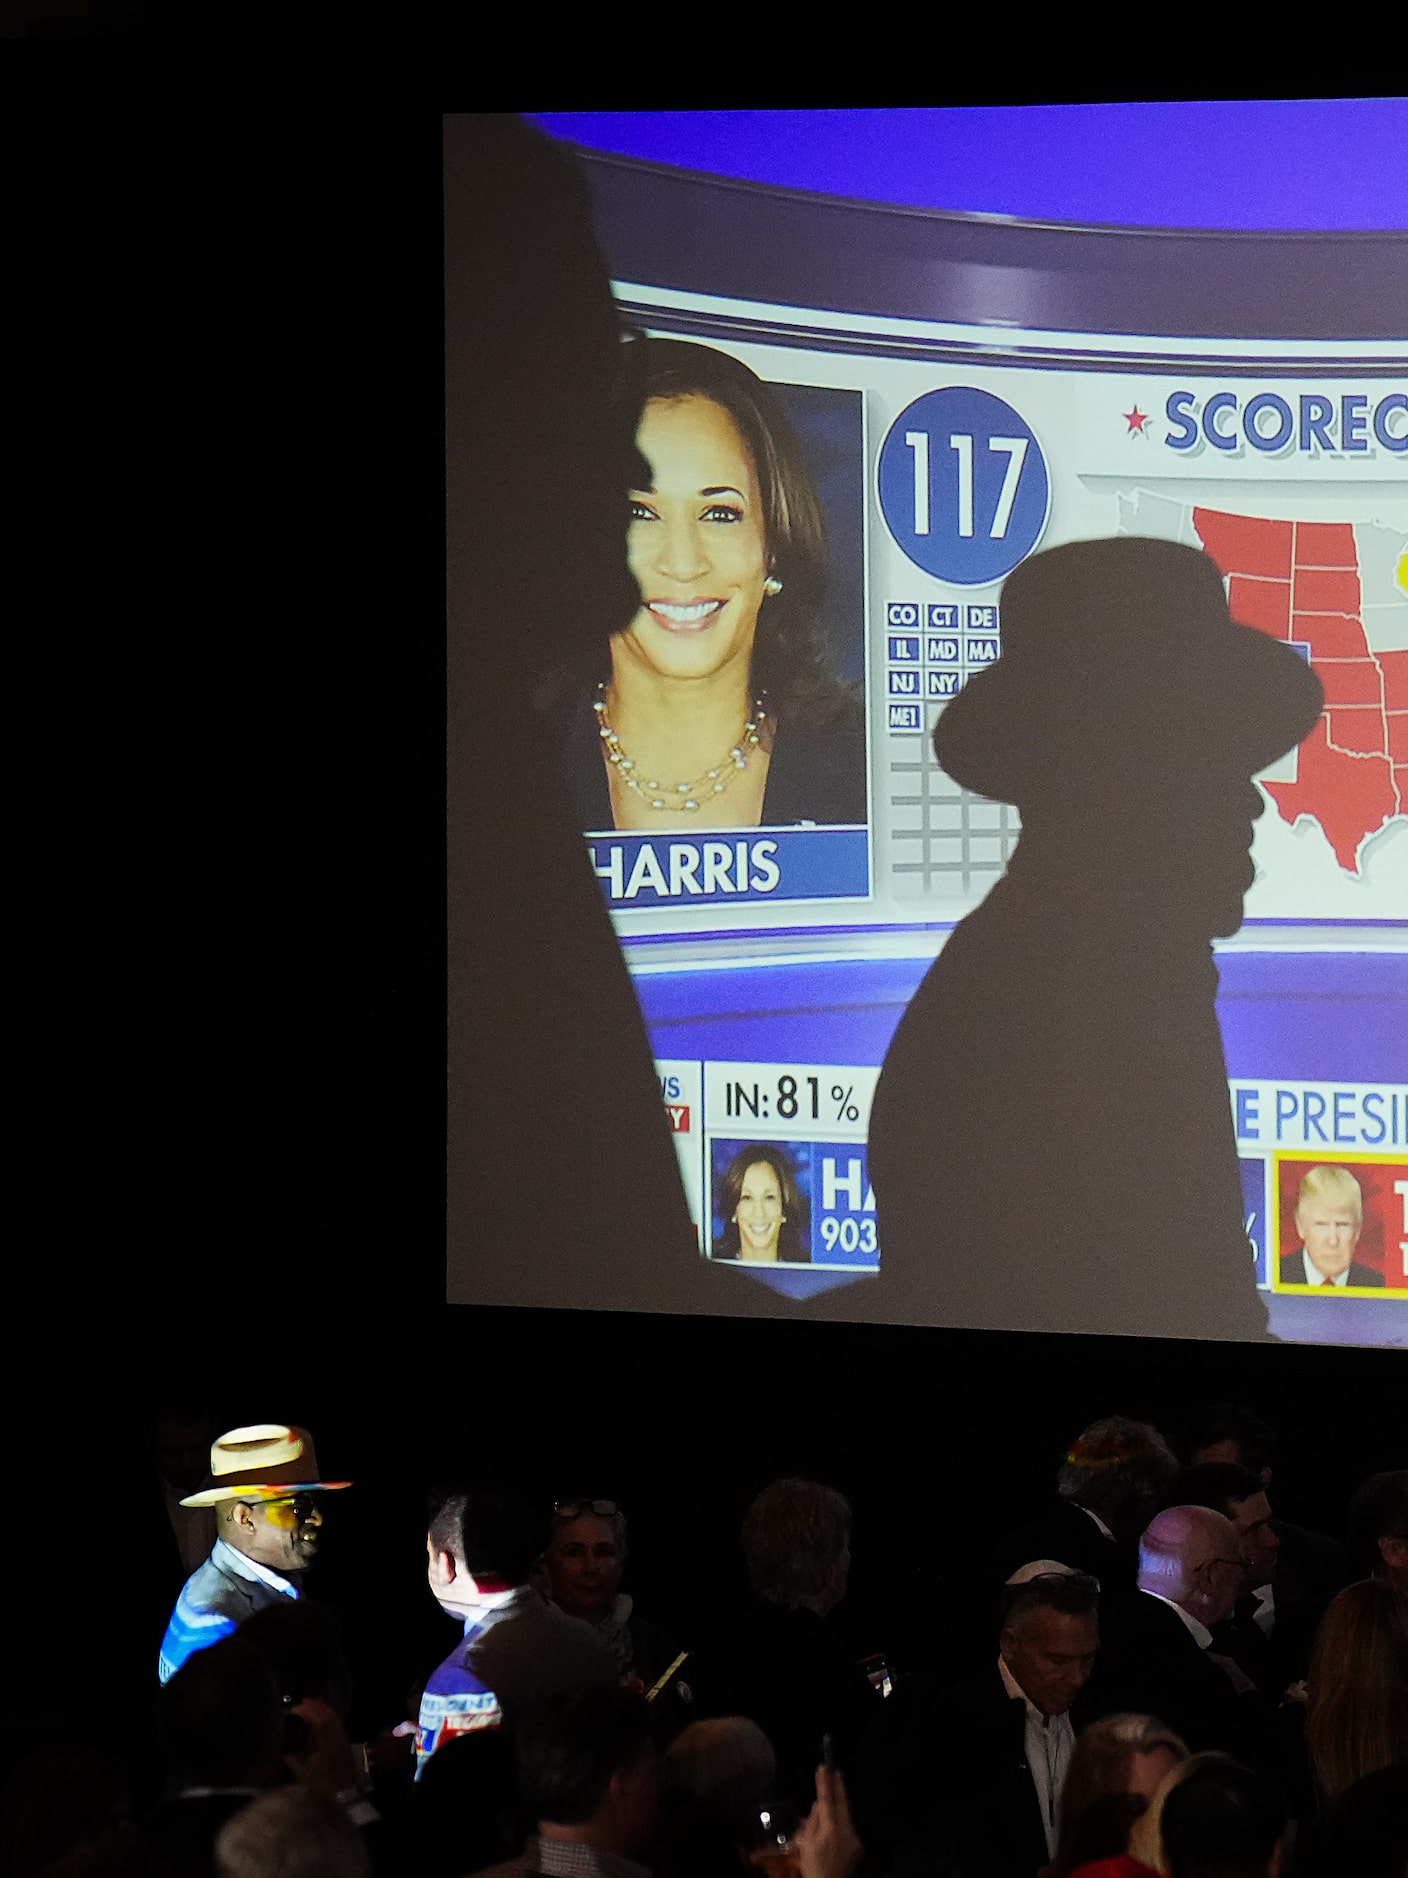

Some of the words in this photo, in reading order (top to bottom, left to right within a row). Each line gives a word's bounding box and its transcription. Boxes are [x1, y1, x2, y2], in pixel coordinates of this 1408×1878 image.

[905, 431, 1030, 538] 117
[889, 605, 916, 625] CO
[931, 607, 953, 626] CT
[970, 608, 993, 627] DE
[896, 639, 912, 659] IL
[929, 640, 957, 660] MD
[968, 641, 996, 660] MA
[891, 673, 915, 693] NJ
[930, 673, 957, 693] NY
[890, 706, 917, 727] ME1
[588, 840, 780, 898] HARRIS
